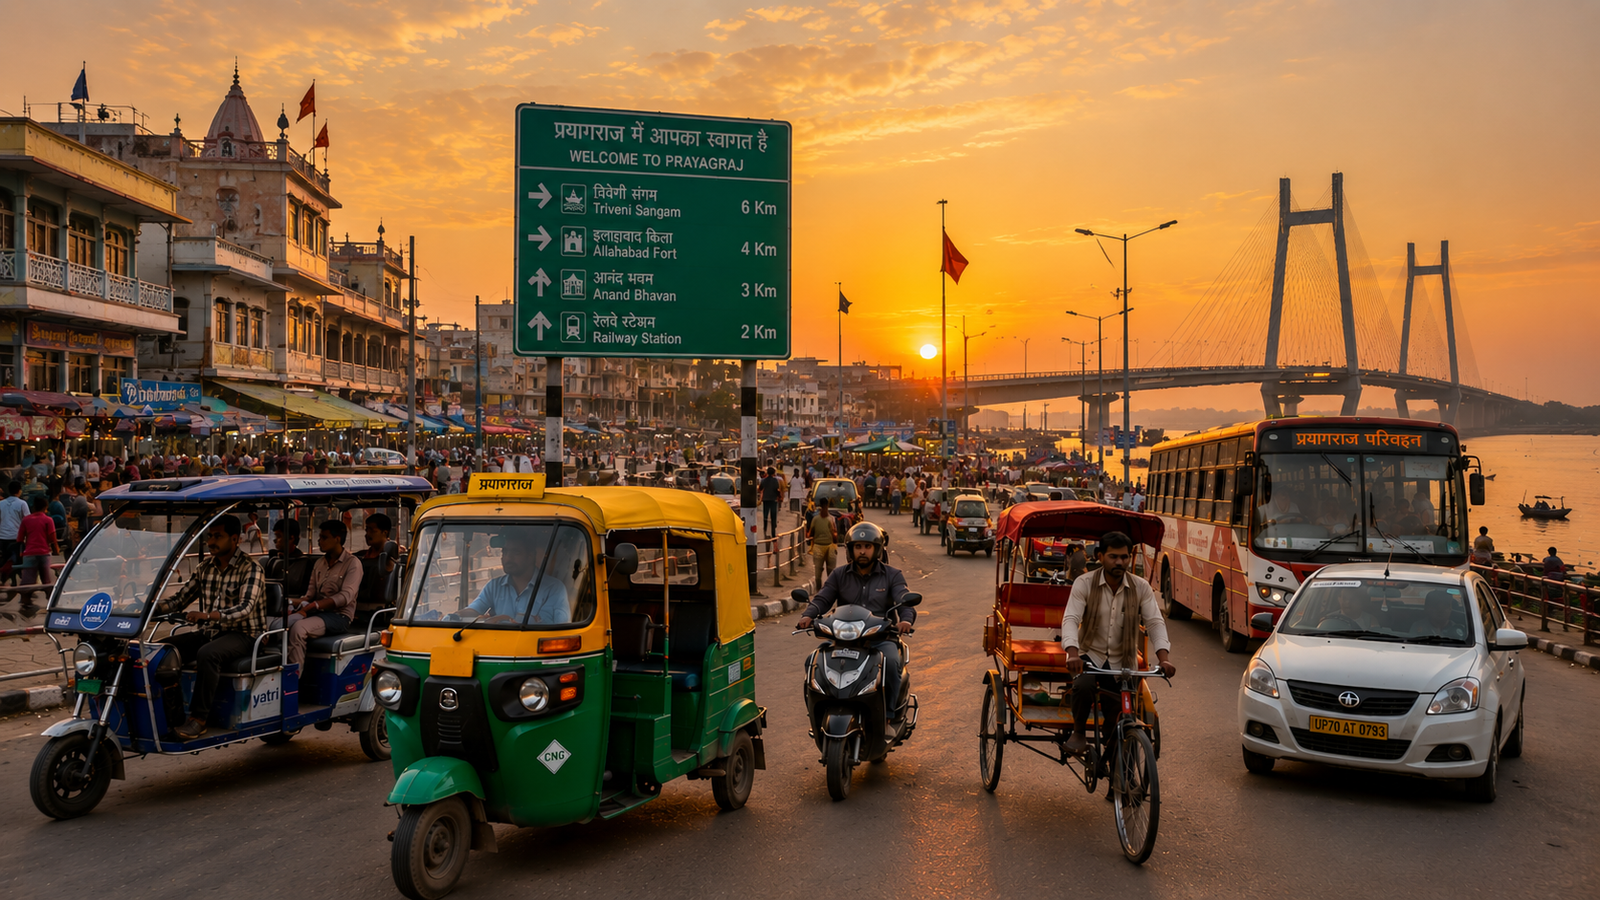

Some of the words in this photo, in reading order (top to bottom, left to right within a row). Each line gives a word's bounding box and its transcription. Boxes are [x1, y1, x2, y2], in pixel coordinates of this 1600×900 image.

[554, 121, 625, 143] प्रयागराज
[630, 121, 645, 143] में
[650, 128, 702, 147] आपका
[706, 131, 754, 150] स्वागत
[757, 128, 769, 153] है
[569, 149, 638, 166] WELCOME
[643, 153, 661, 167] TO
[665, 155, 745, 172] PRAYAGRAJ
[631, 185, 658, 202] संगम
[593, 202, 632, 216] Triveni
[635, 204, 681, 220] Sangam
[741, 199, 750, 215] 6
[754, 200, 777, 216] Km
[645, 227, 674, 244] किला
[592, 243, 650, 259] Allahabad
[653, 246, 678, 260] Fort
[741, 241, 750, 256] 4
[754, 241, 777, 257] Km
[592, 288, 630, 301] Anand
[634, 288, 677, 302] Bhavan
[741, 282, 750, 298] 3
[754, 282, 777, 298] Km
[592, 311, 618, 328] रेलवे
[593, 331, 638, 347] Railway
[641, 332, 682, 345] Station
[741, 324, 750, 339] 2
[754, 324, 777, 340] Km
[1296, 433, 1360, 446] प्रयागराज
[1364, 429, 1422, 449] परिवहन
[84, 599, 110, 617] yatri
[252, 687, 279, 709] yatri
[1315, 718, 1340, 733] UP70
[1343, 722, 1356, 735] AT
[1359, 724, 1386, 738] 0793
[544, 751, 565, 762] CNG
